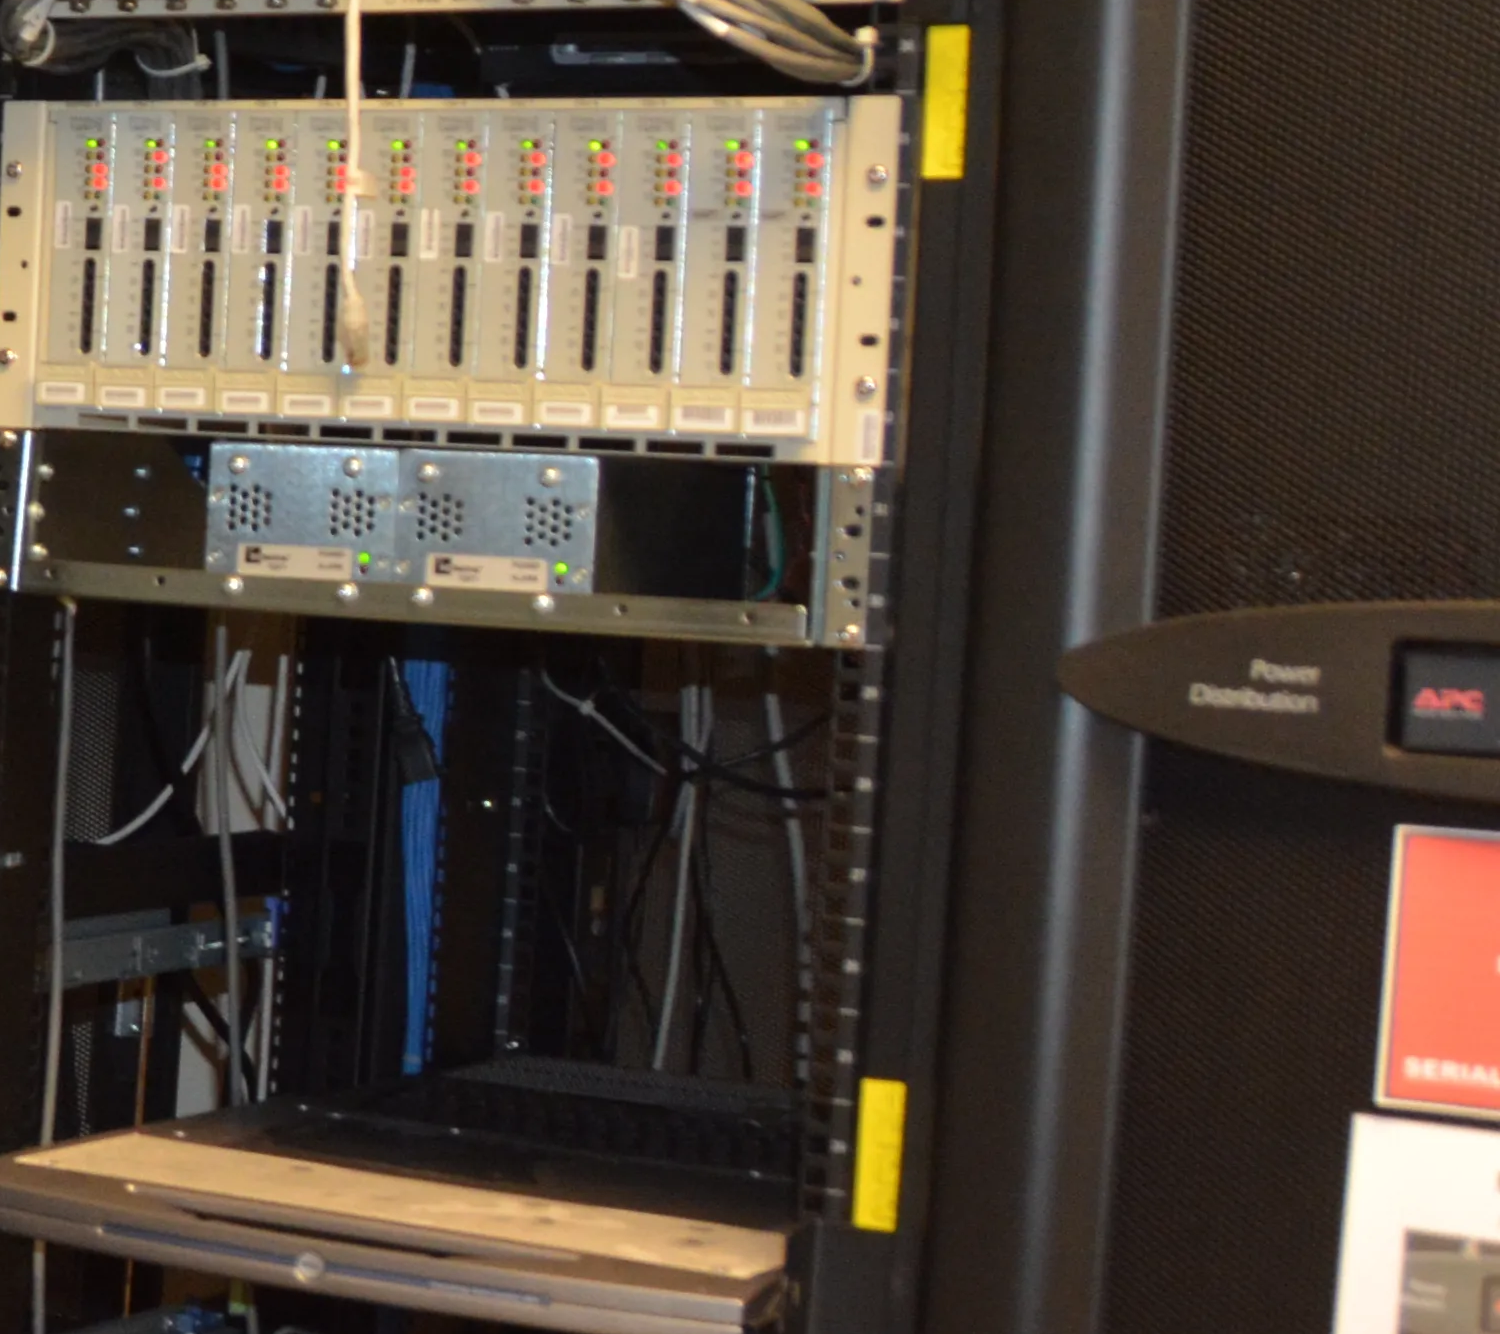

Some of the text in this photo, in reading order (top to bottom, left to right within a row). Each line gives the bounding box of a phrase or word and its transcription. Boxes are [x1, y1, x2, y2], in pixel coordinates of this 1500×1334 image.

[1249, 658, 1321, 685] Power
[1188, 682, 1319, 713] Distribution
[1413, 687, 1485, 712] APC
